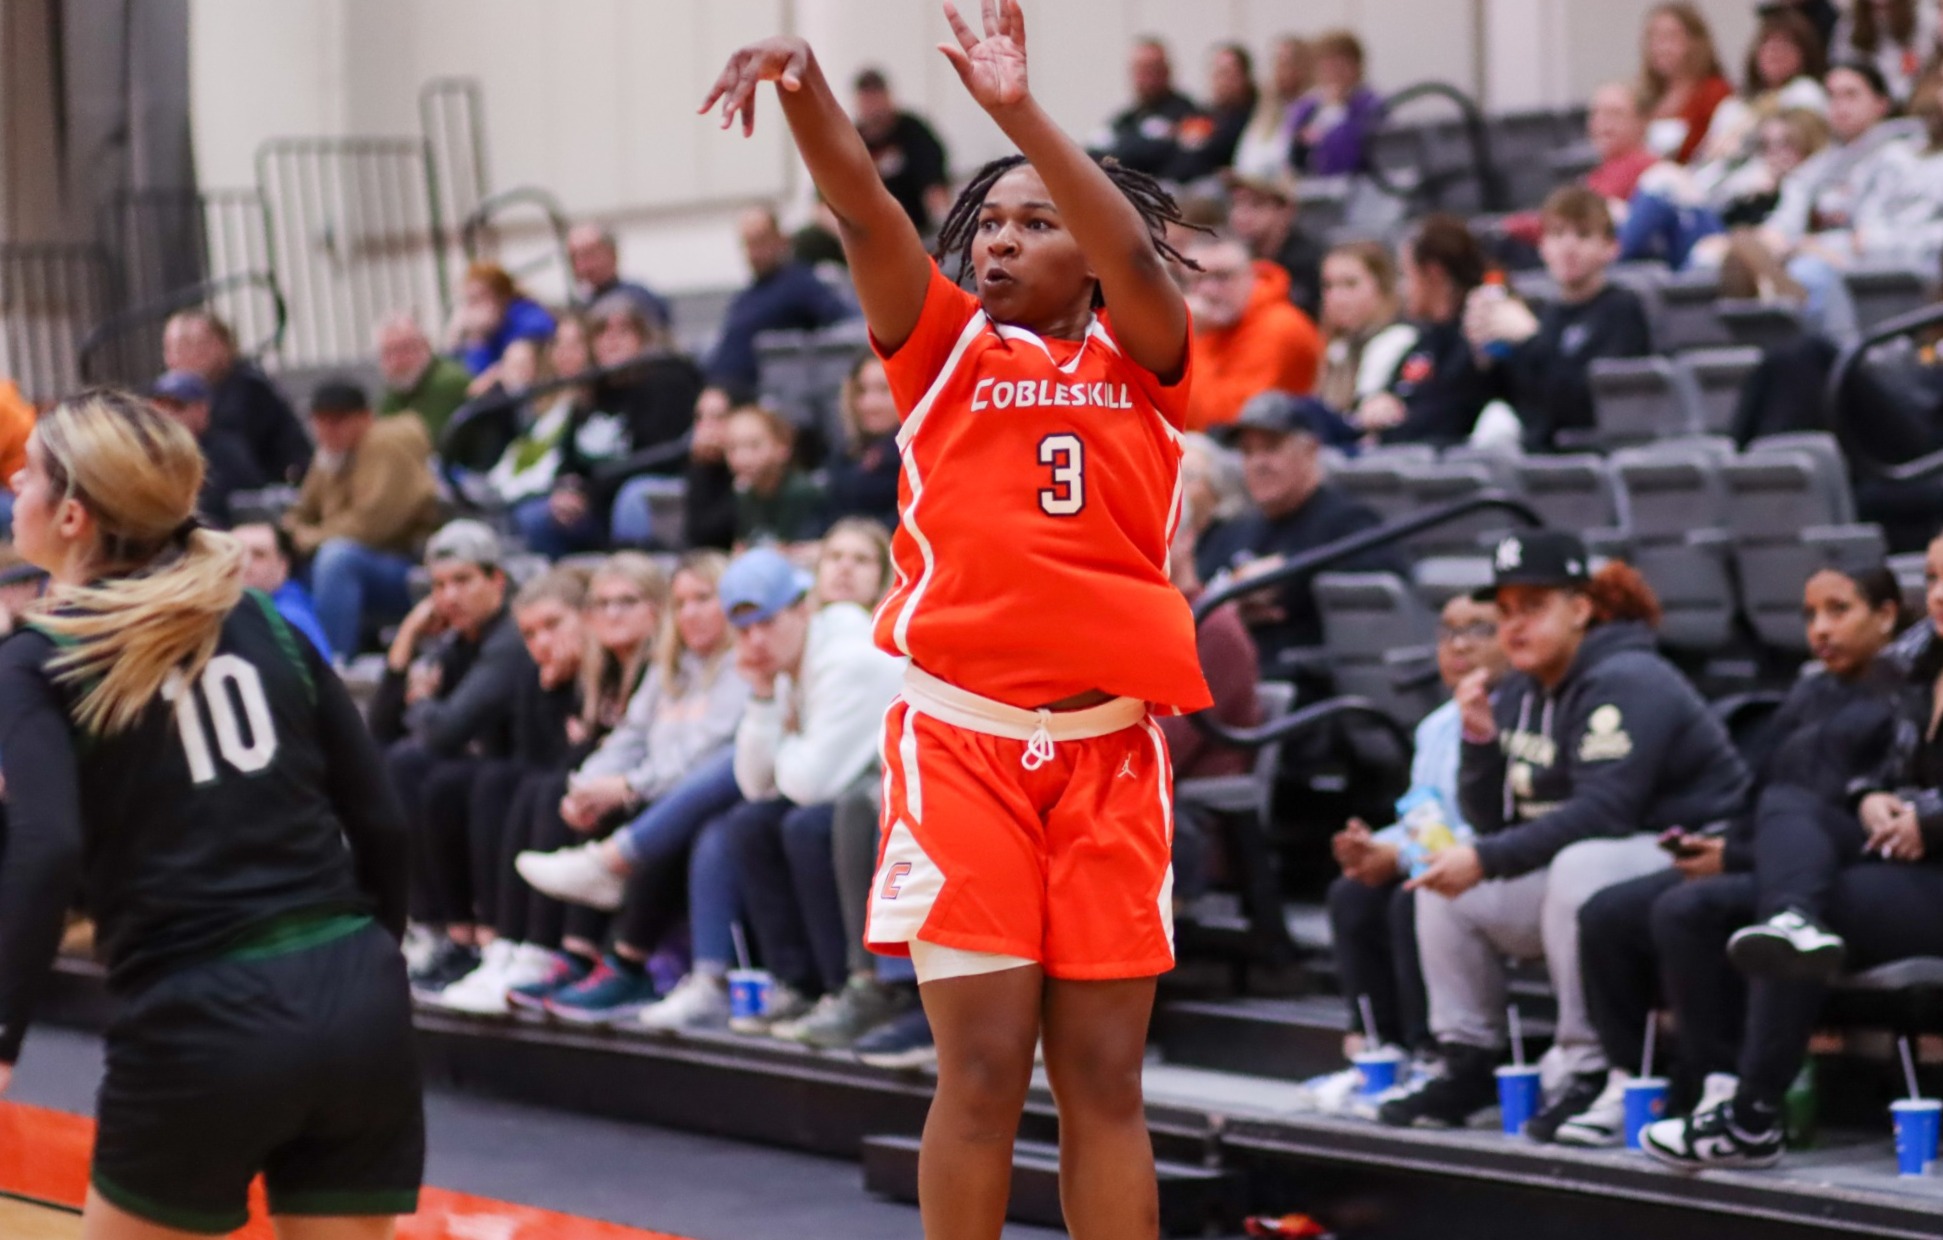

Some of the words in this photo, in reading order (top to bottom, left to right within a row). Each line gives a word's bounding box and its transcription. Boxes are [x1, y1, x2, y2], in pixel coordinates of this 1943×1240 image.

[971, 377, 1132, 411] COBLESKILL
[1037, 432, 1085, 516] 3
[161, 654, 277, 783] 10
[881, 862, 911, 899] C
